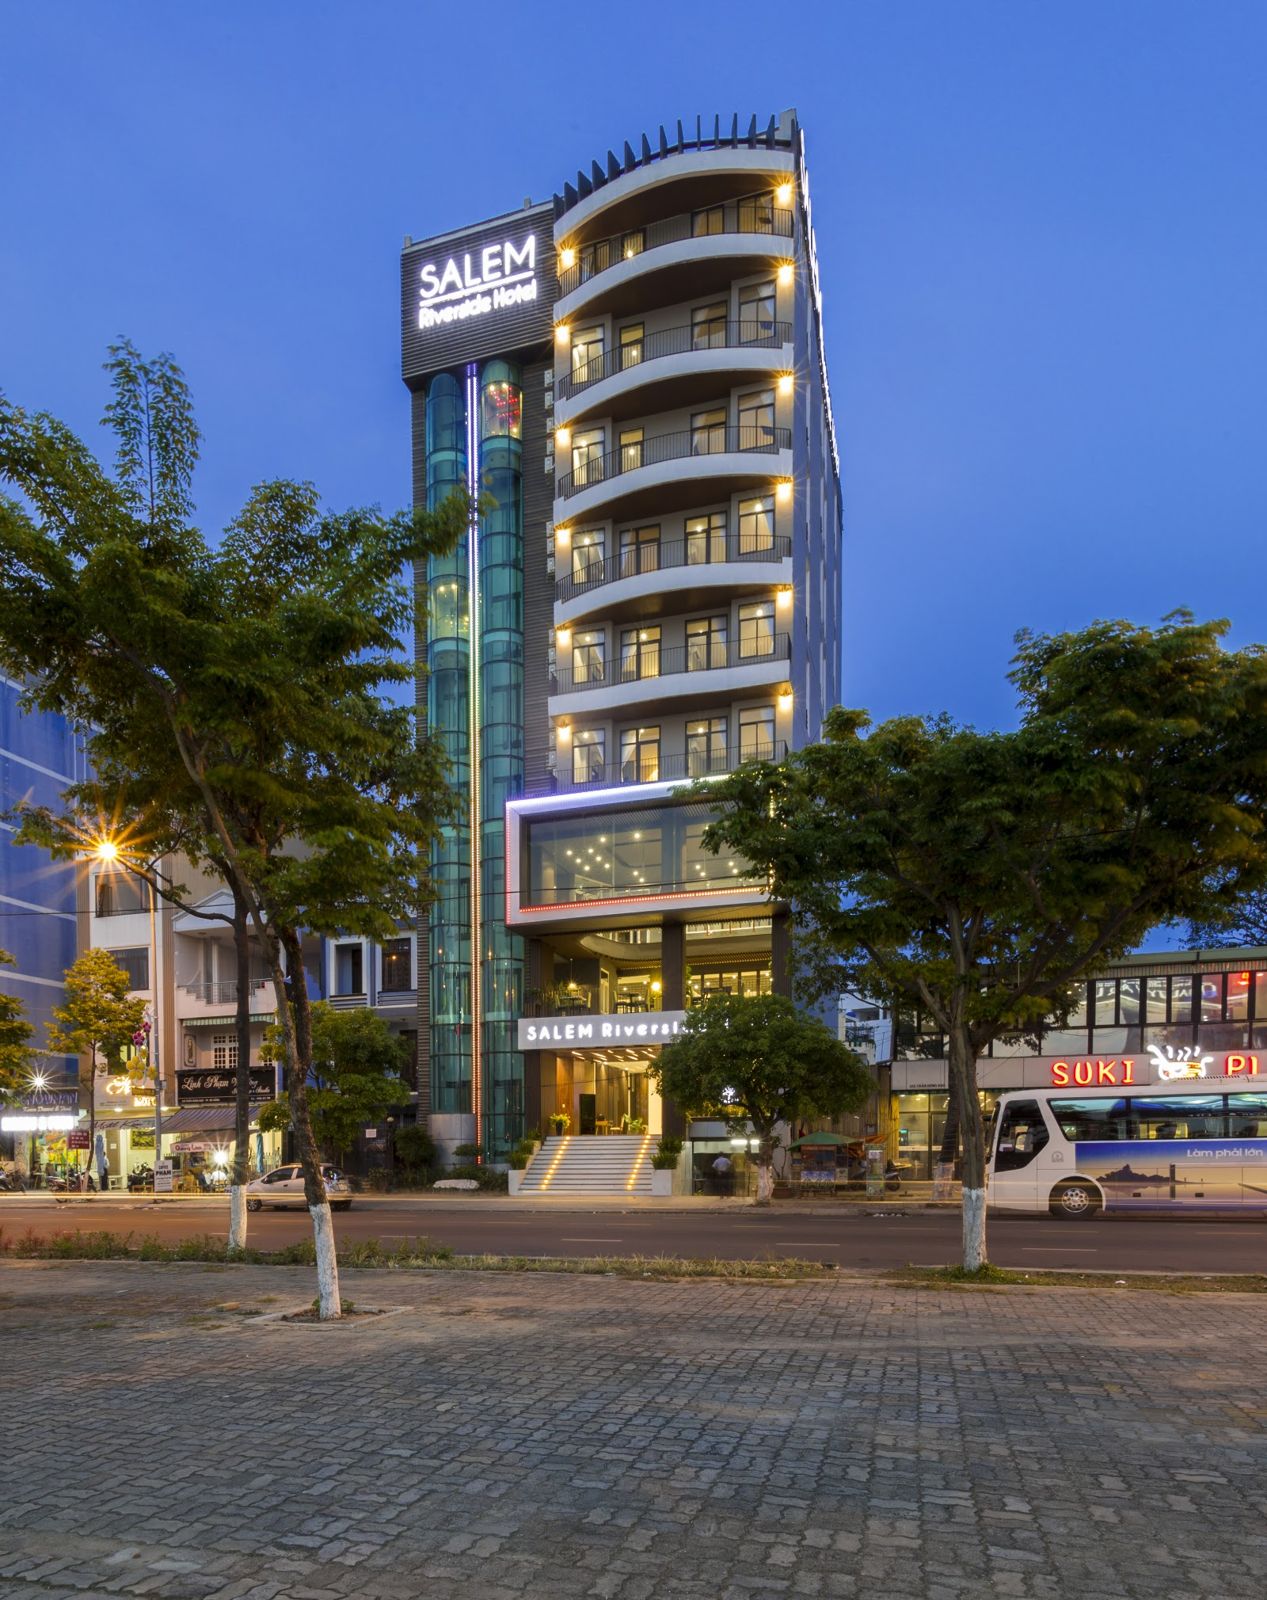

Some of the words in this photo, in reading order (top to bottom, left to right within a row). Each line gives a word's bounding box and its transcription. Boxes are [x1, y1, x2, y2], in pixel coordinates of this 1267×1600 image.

[420, 235, 536, 298] SALEM
[419, 294, 491, 329] Riverside
[493, 279, 537, 309] Hotel
[526, 1024, 593, 1041] SALEM
[1052, 1060, 1134, 1087] SUKI
